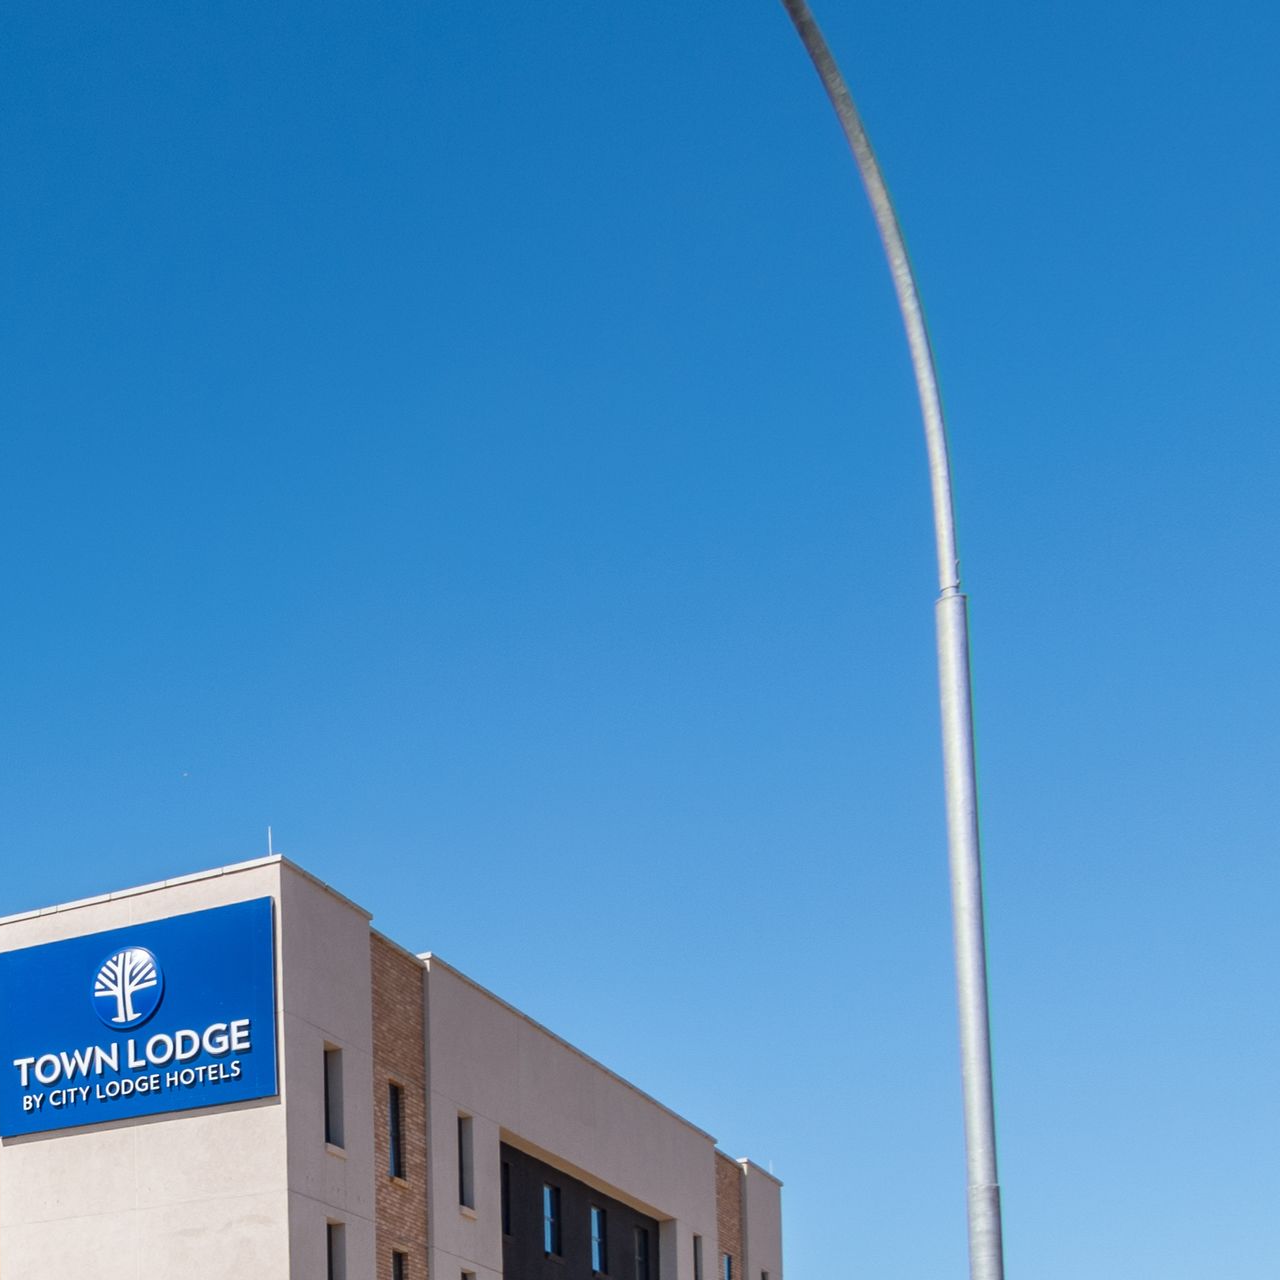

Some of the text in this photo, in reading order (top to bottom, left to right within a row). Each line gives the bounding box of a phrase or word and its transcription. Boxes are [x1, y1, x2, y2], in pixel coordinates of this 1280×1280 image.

[13, 1018, 251, 1087] TOWN LODGE
[23, 1060, 241, 1111] BY CITY LODGE HOTELS
